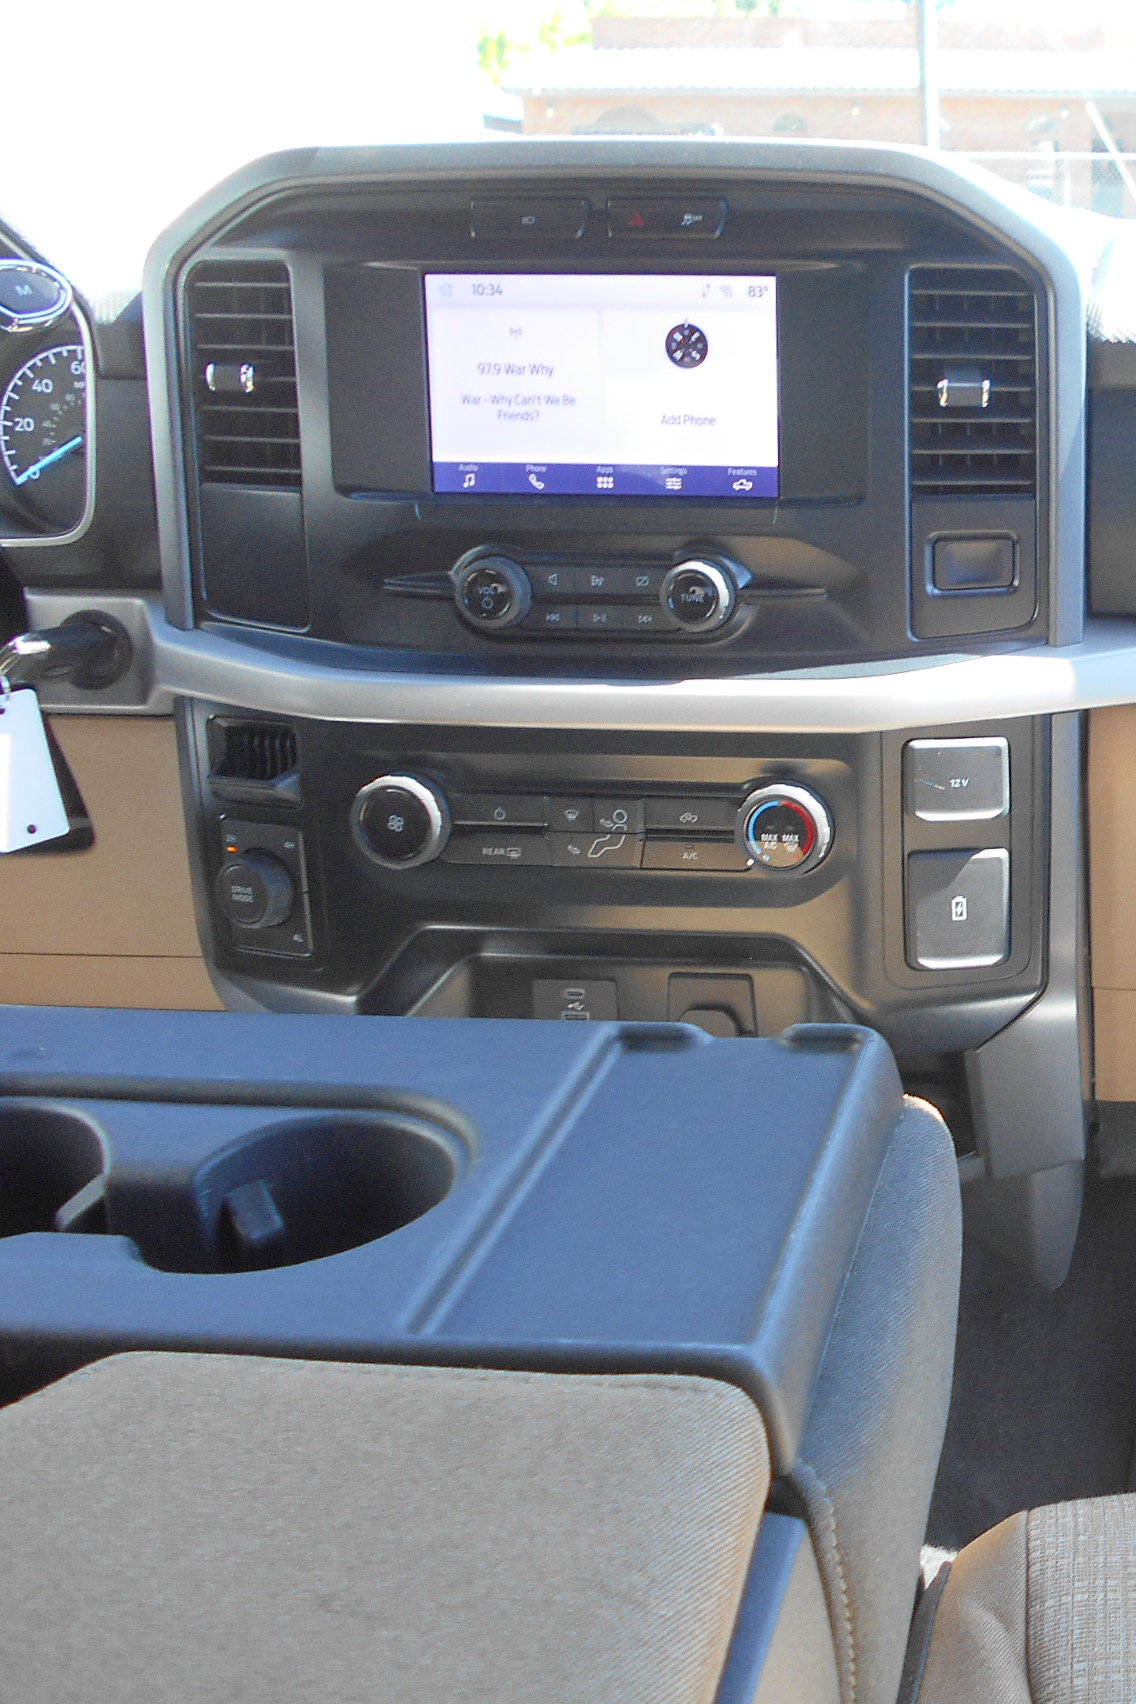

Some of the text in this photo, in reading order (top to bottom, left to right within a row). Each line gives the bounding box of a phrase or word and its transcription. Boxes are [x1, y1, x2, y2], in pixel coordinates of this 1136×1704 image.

[472, 283, 503, 297] 10:34
[748, 284, 769, 298] 83°
[505, 363, 526, 376] War
[529, 364, 554, 378] Why
[32, 380, 53, 393] 40
[461, 394, 482, 406] War
[491, 394, 513, 408] Why
[544, 394, 561, 407] We
[497, 408, 540, 423] Friends?
[661, 414, 716, 427] Add Phone
[15, 418, 34, 432] 20
[458, 463, 478, 473] Audio
[526, 464, 547, 474] Phone
[597, 465, 614, 475] Apps
[728, 468, 757, 478] Features
[760, 833, 778, 841] MAX
[782, 833, 800, 841] MAX
[682, 852, 699, 861] A/C
